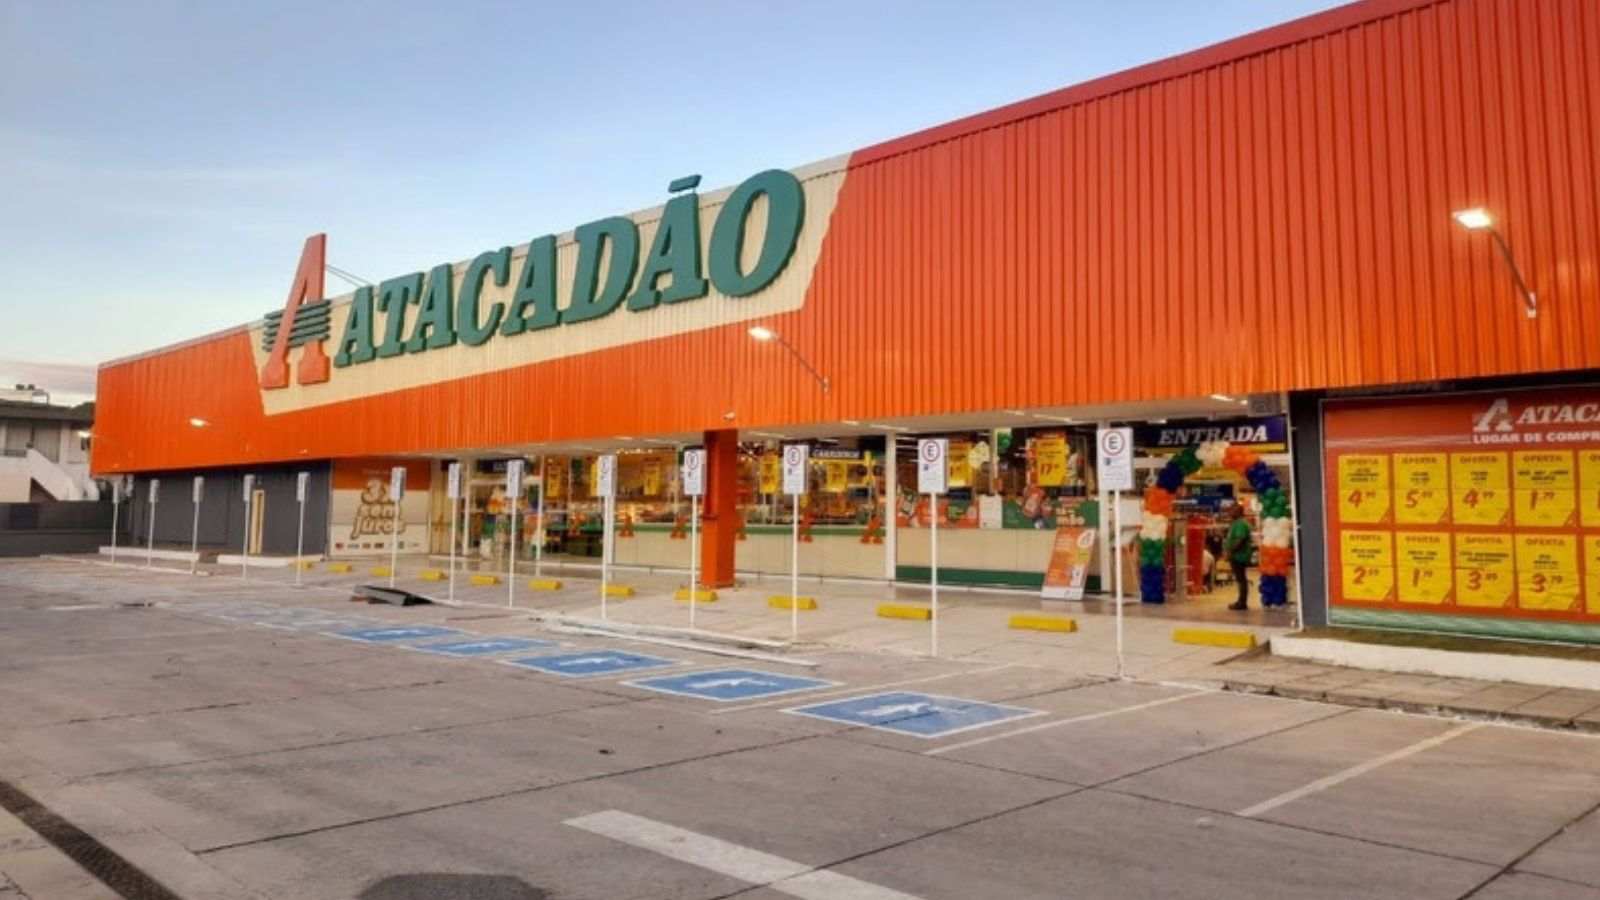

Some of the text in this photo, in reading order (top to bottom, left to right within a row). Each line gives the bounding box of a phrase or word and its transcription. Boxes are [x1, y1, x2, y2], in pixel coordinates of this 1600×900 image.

[333, 169, 806, 368] ATACADÃO
[1516, 403, 1600, 424] ATAC
[1158, 425, 1267, 445] ENTRADA
[1473, 433, 1520, 444] LUGAR
[1524, 432, 1542, 443] DE
[1348, 490, 1362, 508] 4
[1405, 489, 1419, 508] 5
[1463, 489, 1478, 509] 4
[1353, 566, 1366, 585] 2
[1467, 571, 1481, 591] 3
[1531, 573, 1547, 593] 3
